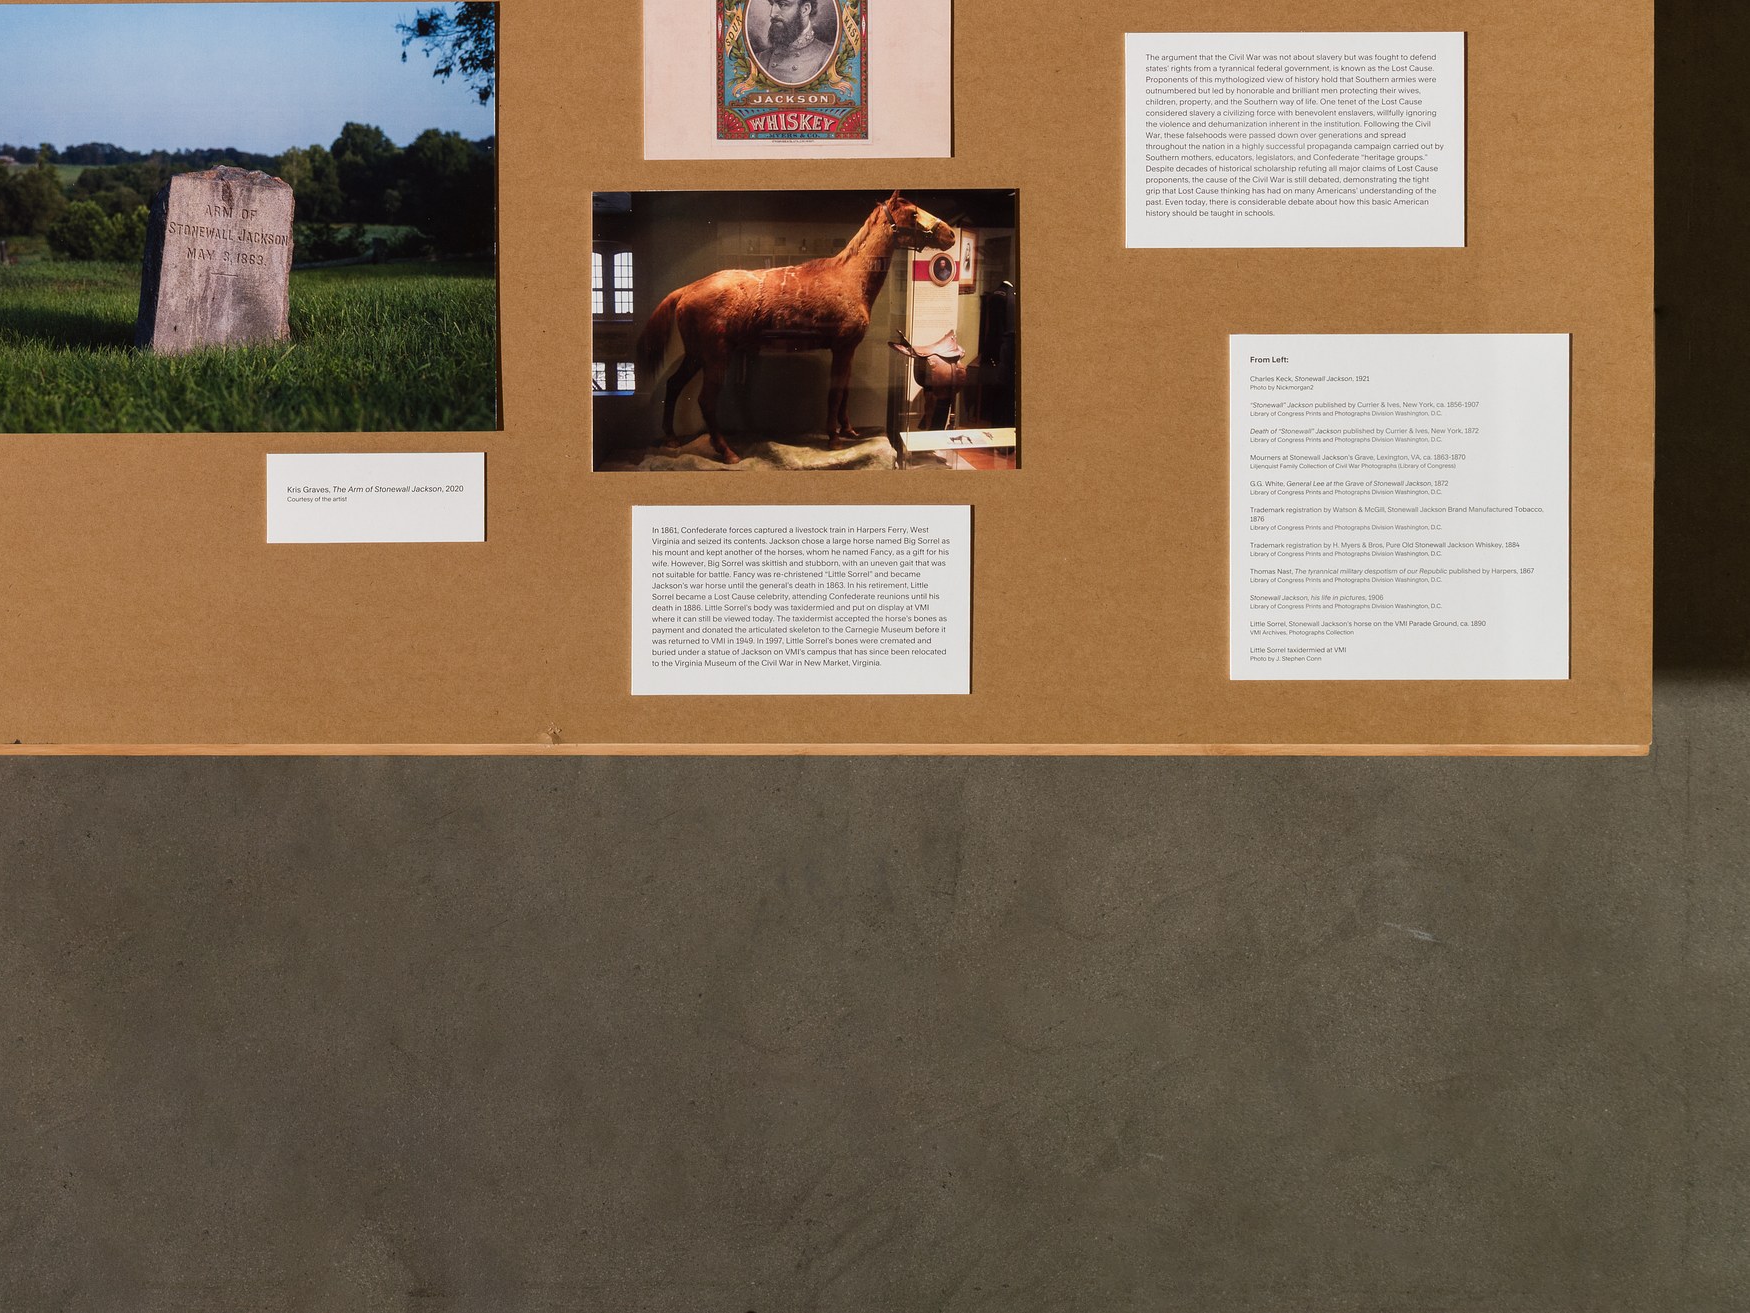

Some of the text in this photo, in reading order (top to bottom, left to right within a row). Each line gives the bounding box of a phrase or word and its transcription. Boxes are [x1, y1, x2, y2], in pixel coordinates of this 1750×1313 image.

[726, 15, 743, 46] SOUR
[843, 15, 860, 46] MASH
[750, 113, 836, 131] WHISKEY
[205, 205, 257, 220] ARM OF
[1210, 209, 1234, 218] taught
[168, 221, 288, 246] STONEWALL JACKSON
[187, 247, 215, 260] MAY
[302, 485, 330, 493] Graves,
[411, 485, 444, 493] Jackson,
[445, 484, 463, 492] 2020
[674, 659, 702, 668] Virginia
[803, 658, 821, 666] New
[852, 659, 881, 667] Virginia.
